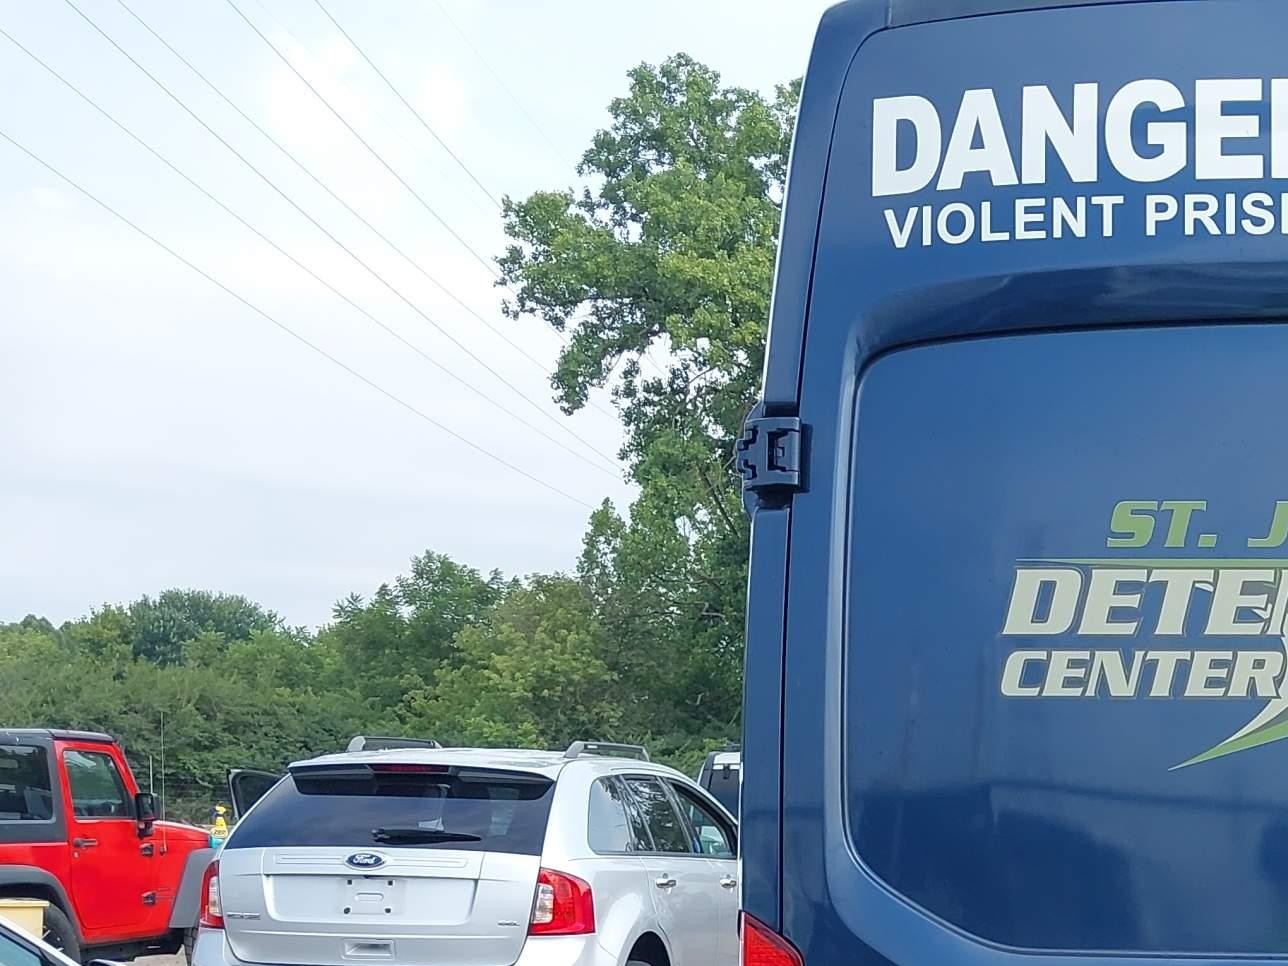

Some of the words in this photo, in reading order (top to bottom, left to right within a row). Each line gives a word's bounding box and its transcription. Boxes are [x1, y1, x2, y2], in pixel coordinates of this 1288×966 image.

[884, 195, 1124, 248] VIOLENT
[1106, 499, 1218, 548] ST.
[1000, 649, 1286, 699] CENTER
